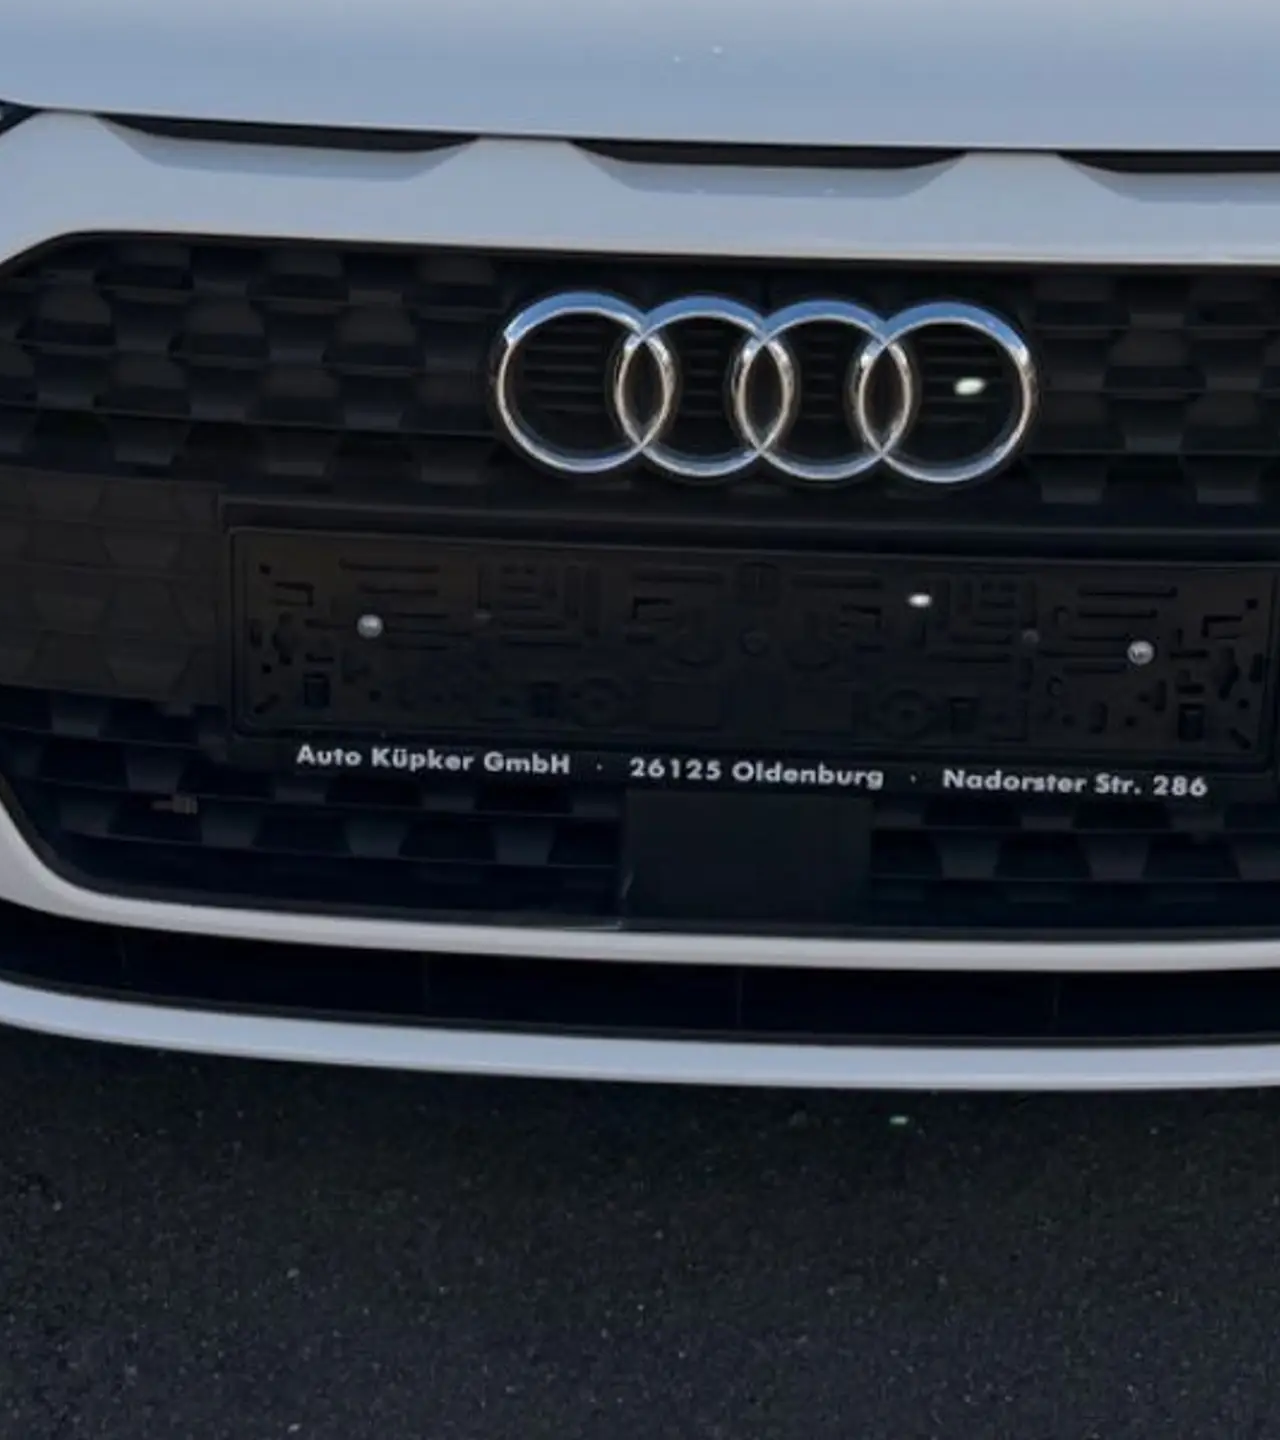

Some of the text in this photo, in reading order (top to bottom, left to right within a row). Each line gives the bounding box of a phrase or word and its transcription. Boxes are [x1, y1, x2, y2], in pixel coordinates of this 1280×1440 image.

[297, 744, 1208, 797] Auto Küpker GmbH 26125 Oldenburg Nadorster Str. 286
